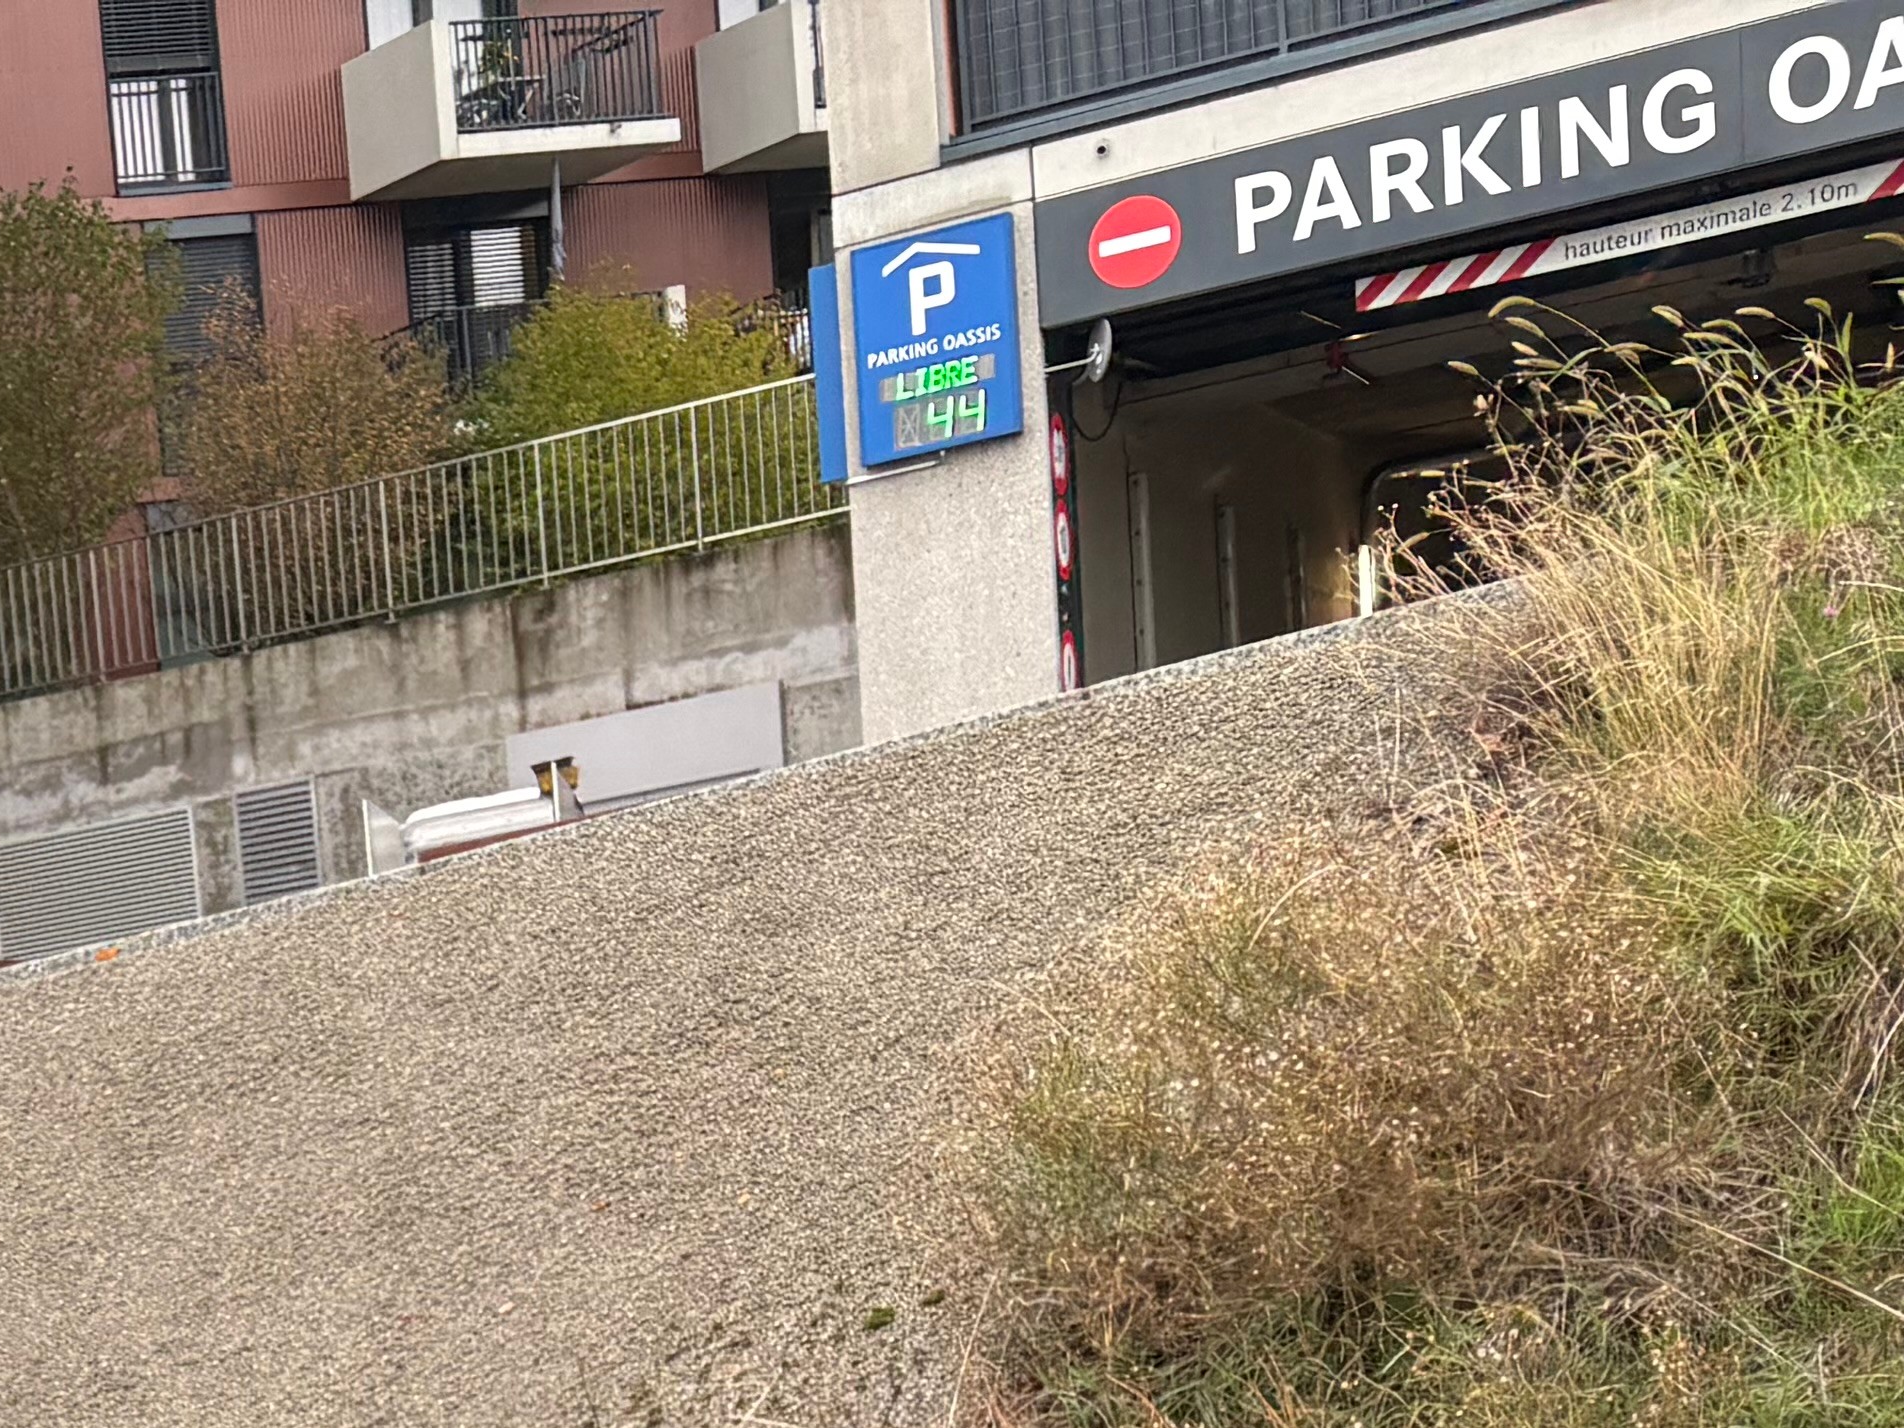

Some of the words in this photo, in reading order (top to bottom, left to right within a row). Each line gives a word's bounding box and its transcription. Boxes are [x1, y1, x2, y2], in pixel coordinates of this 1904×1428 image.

[1234, 68, 1717, 255] PARKING
[1563, 227, 1652, 261] hauteur
[1660, 199, 1772, 241] maximale
[1781, 179, 1858, 212] 2.10m
[908, 260, 956, 336] P
[867, 338, 939, 369] PARKING
[943, 323, 1002, 351] OASSIS
[895, 355, 979, 401] LIBRE
[927, 389, 986, 438] 44
